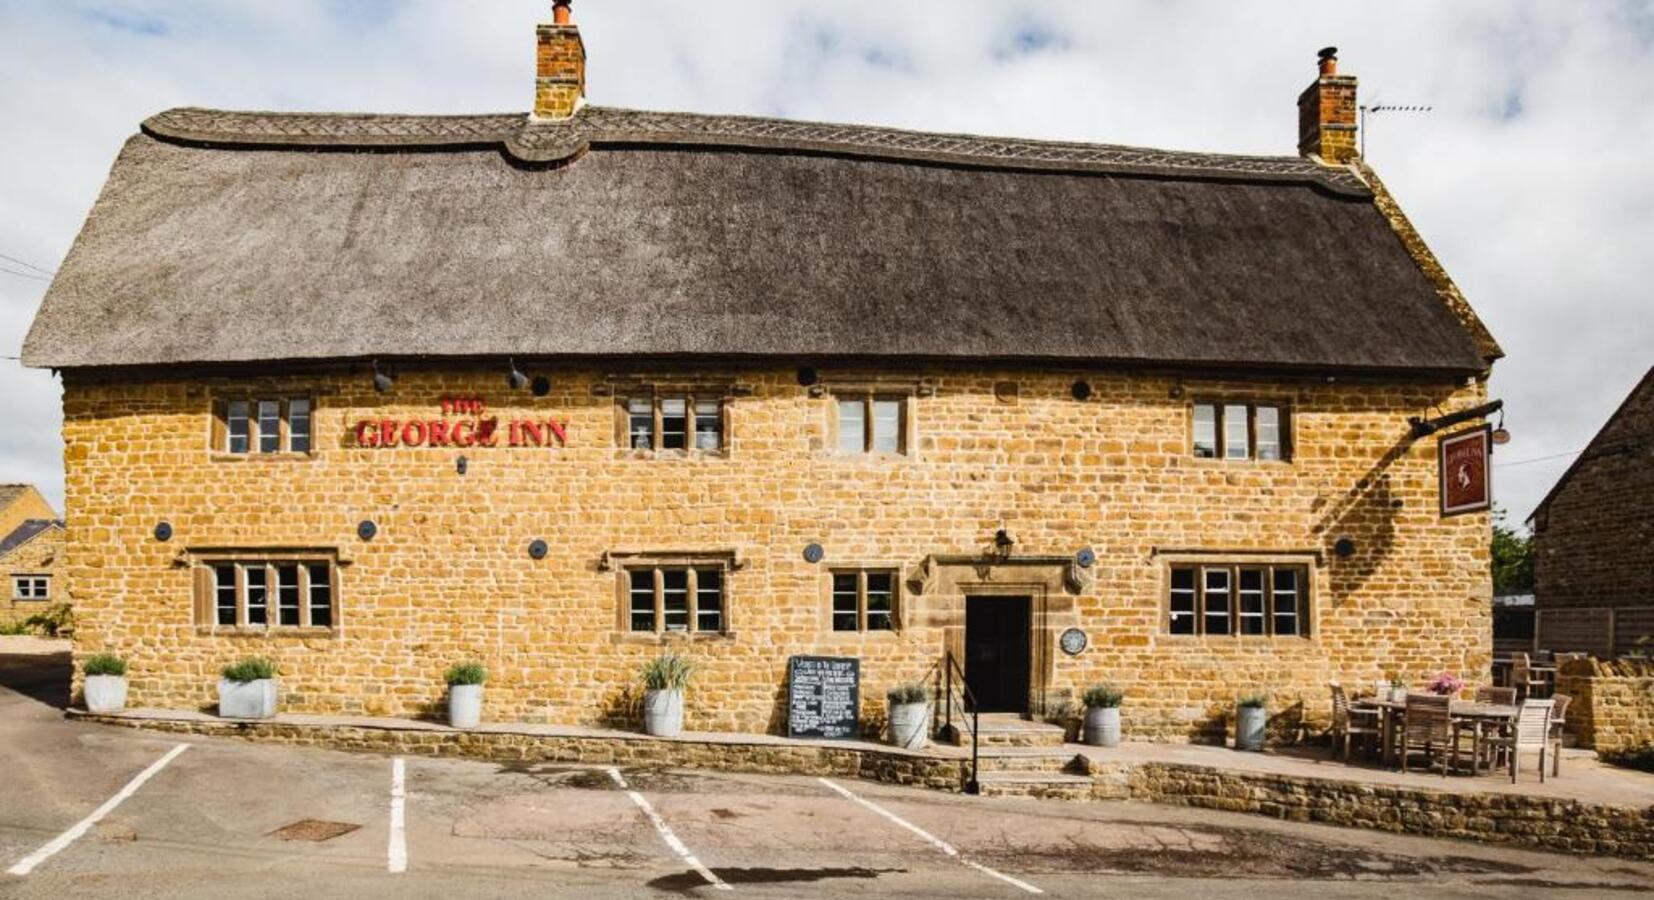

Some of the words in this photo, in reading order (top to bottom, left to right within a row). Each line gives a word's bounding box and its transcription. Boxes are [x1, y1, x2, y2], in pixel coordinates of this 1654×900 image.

[440, 397, 484, 414] THE
[356, 419, 498, 447] GEORGE
[509, 417, 569, 447] INN
